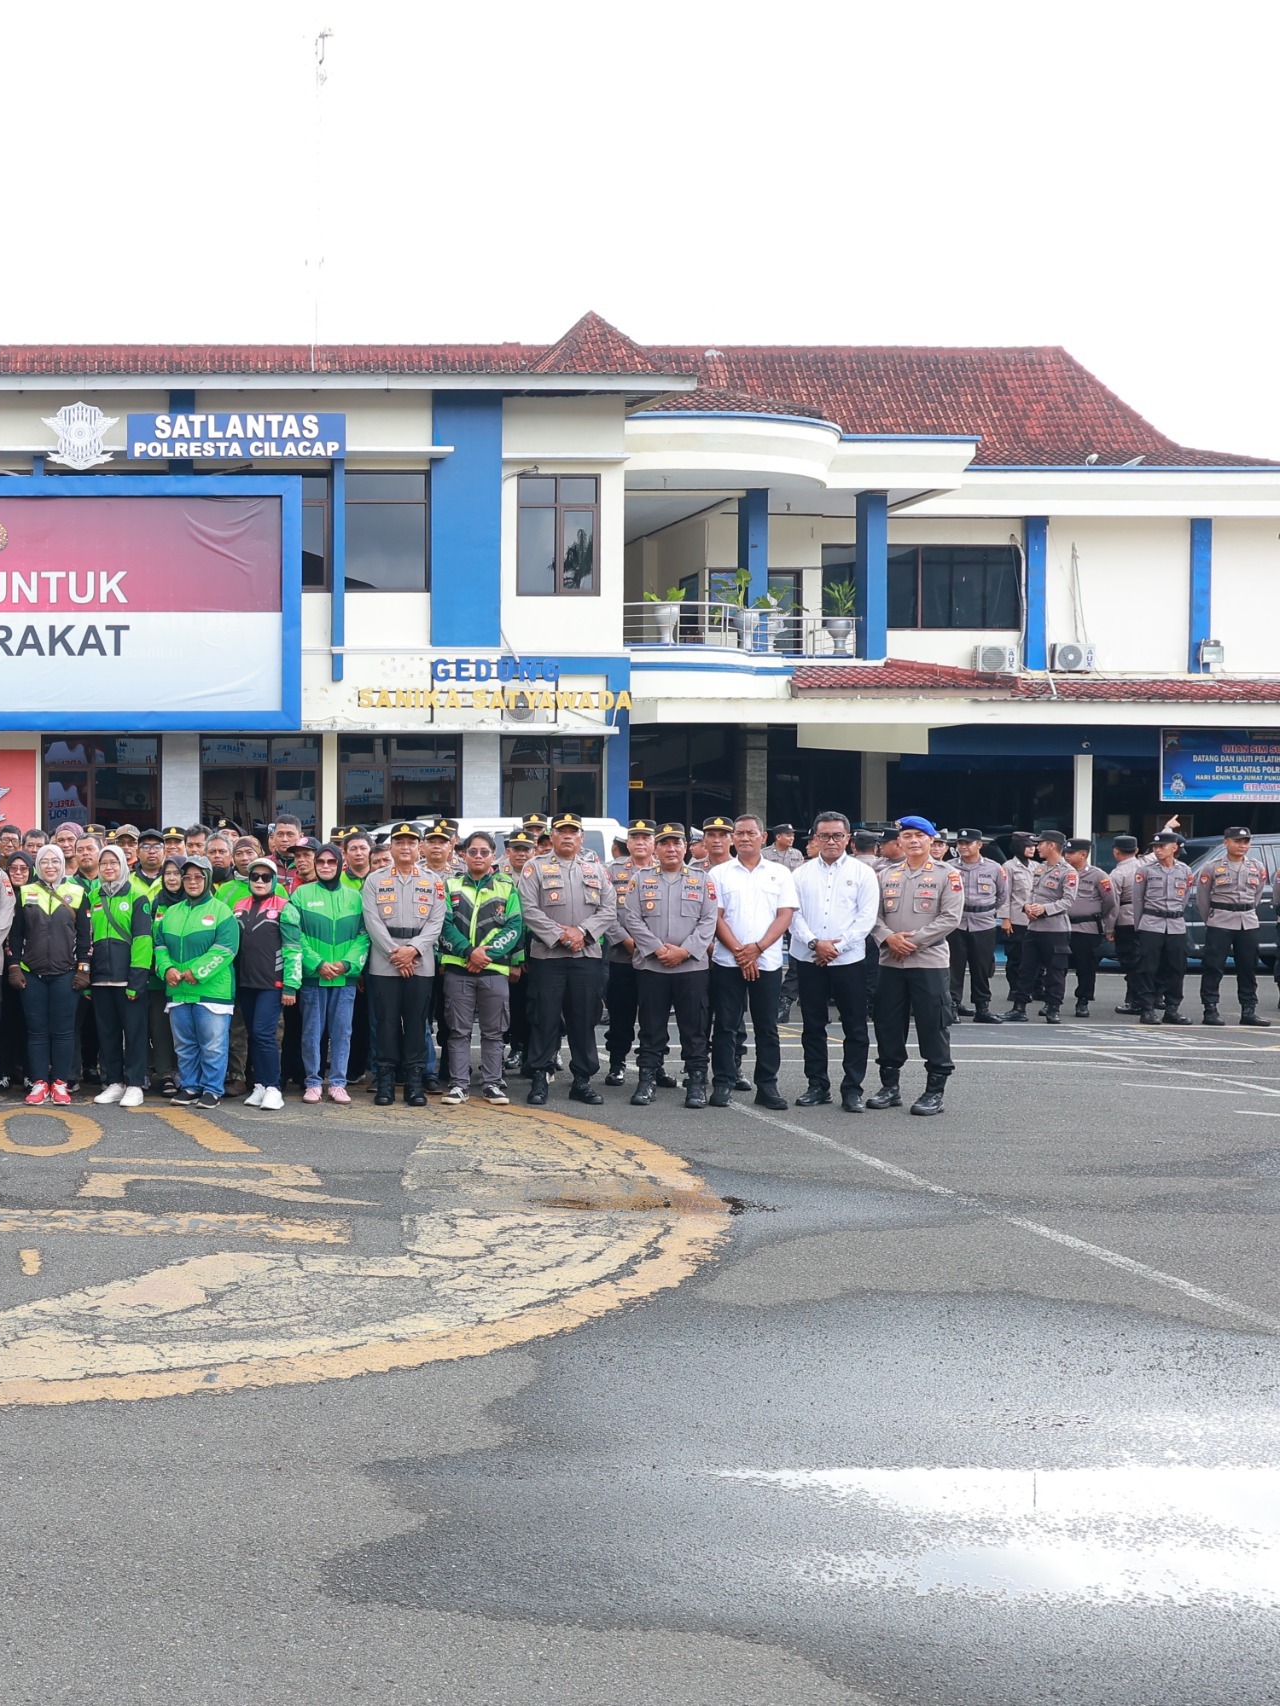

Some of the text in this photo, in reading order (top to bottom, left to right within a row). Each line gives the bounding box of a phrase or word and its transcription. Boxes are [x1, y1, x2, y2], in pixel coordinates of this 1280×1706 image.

[154, 414, 319, 439] SATLANTAS
[133, 441, 340, 458] POLRESTA CILACAP
[431, 658, 560, 683] GEDUNG
[358, 688, 633, 711] SANIKA SATYAWADA
[1220, 755, 1235, 763] DAN
[1236, 755, 1253, 763] IKUTI
[1222, 745, 1249, 753] UJIAN
[1250, 745, 1268, 753] SIM
[197, 955, 224, 978] Grab
